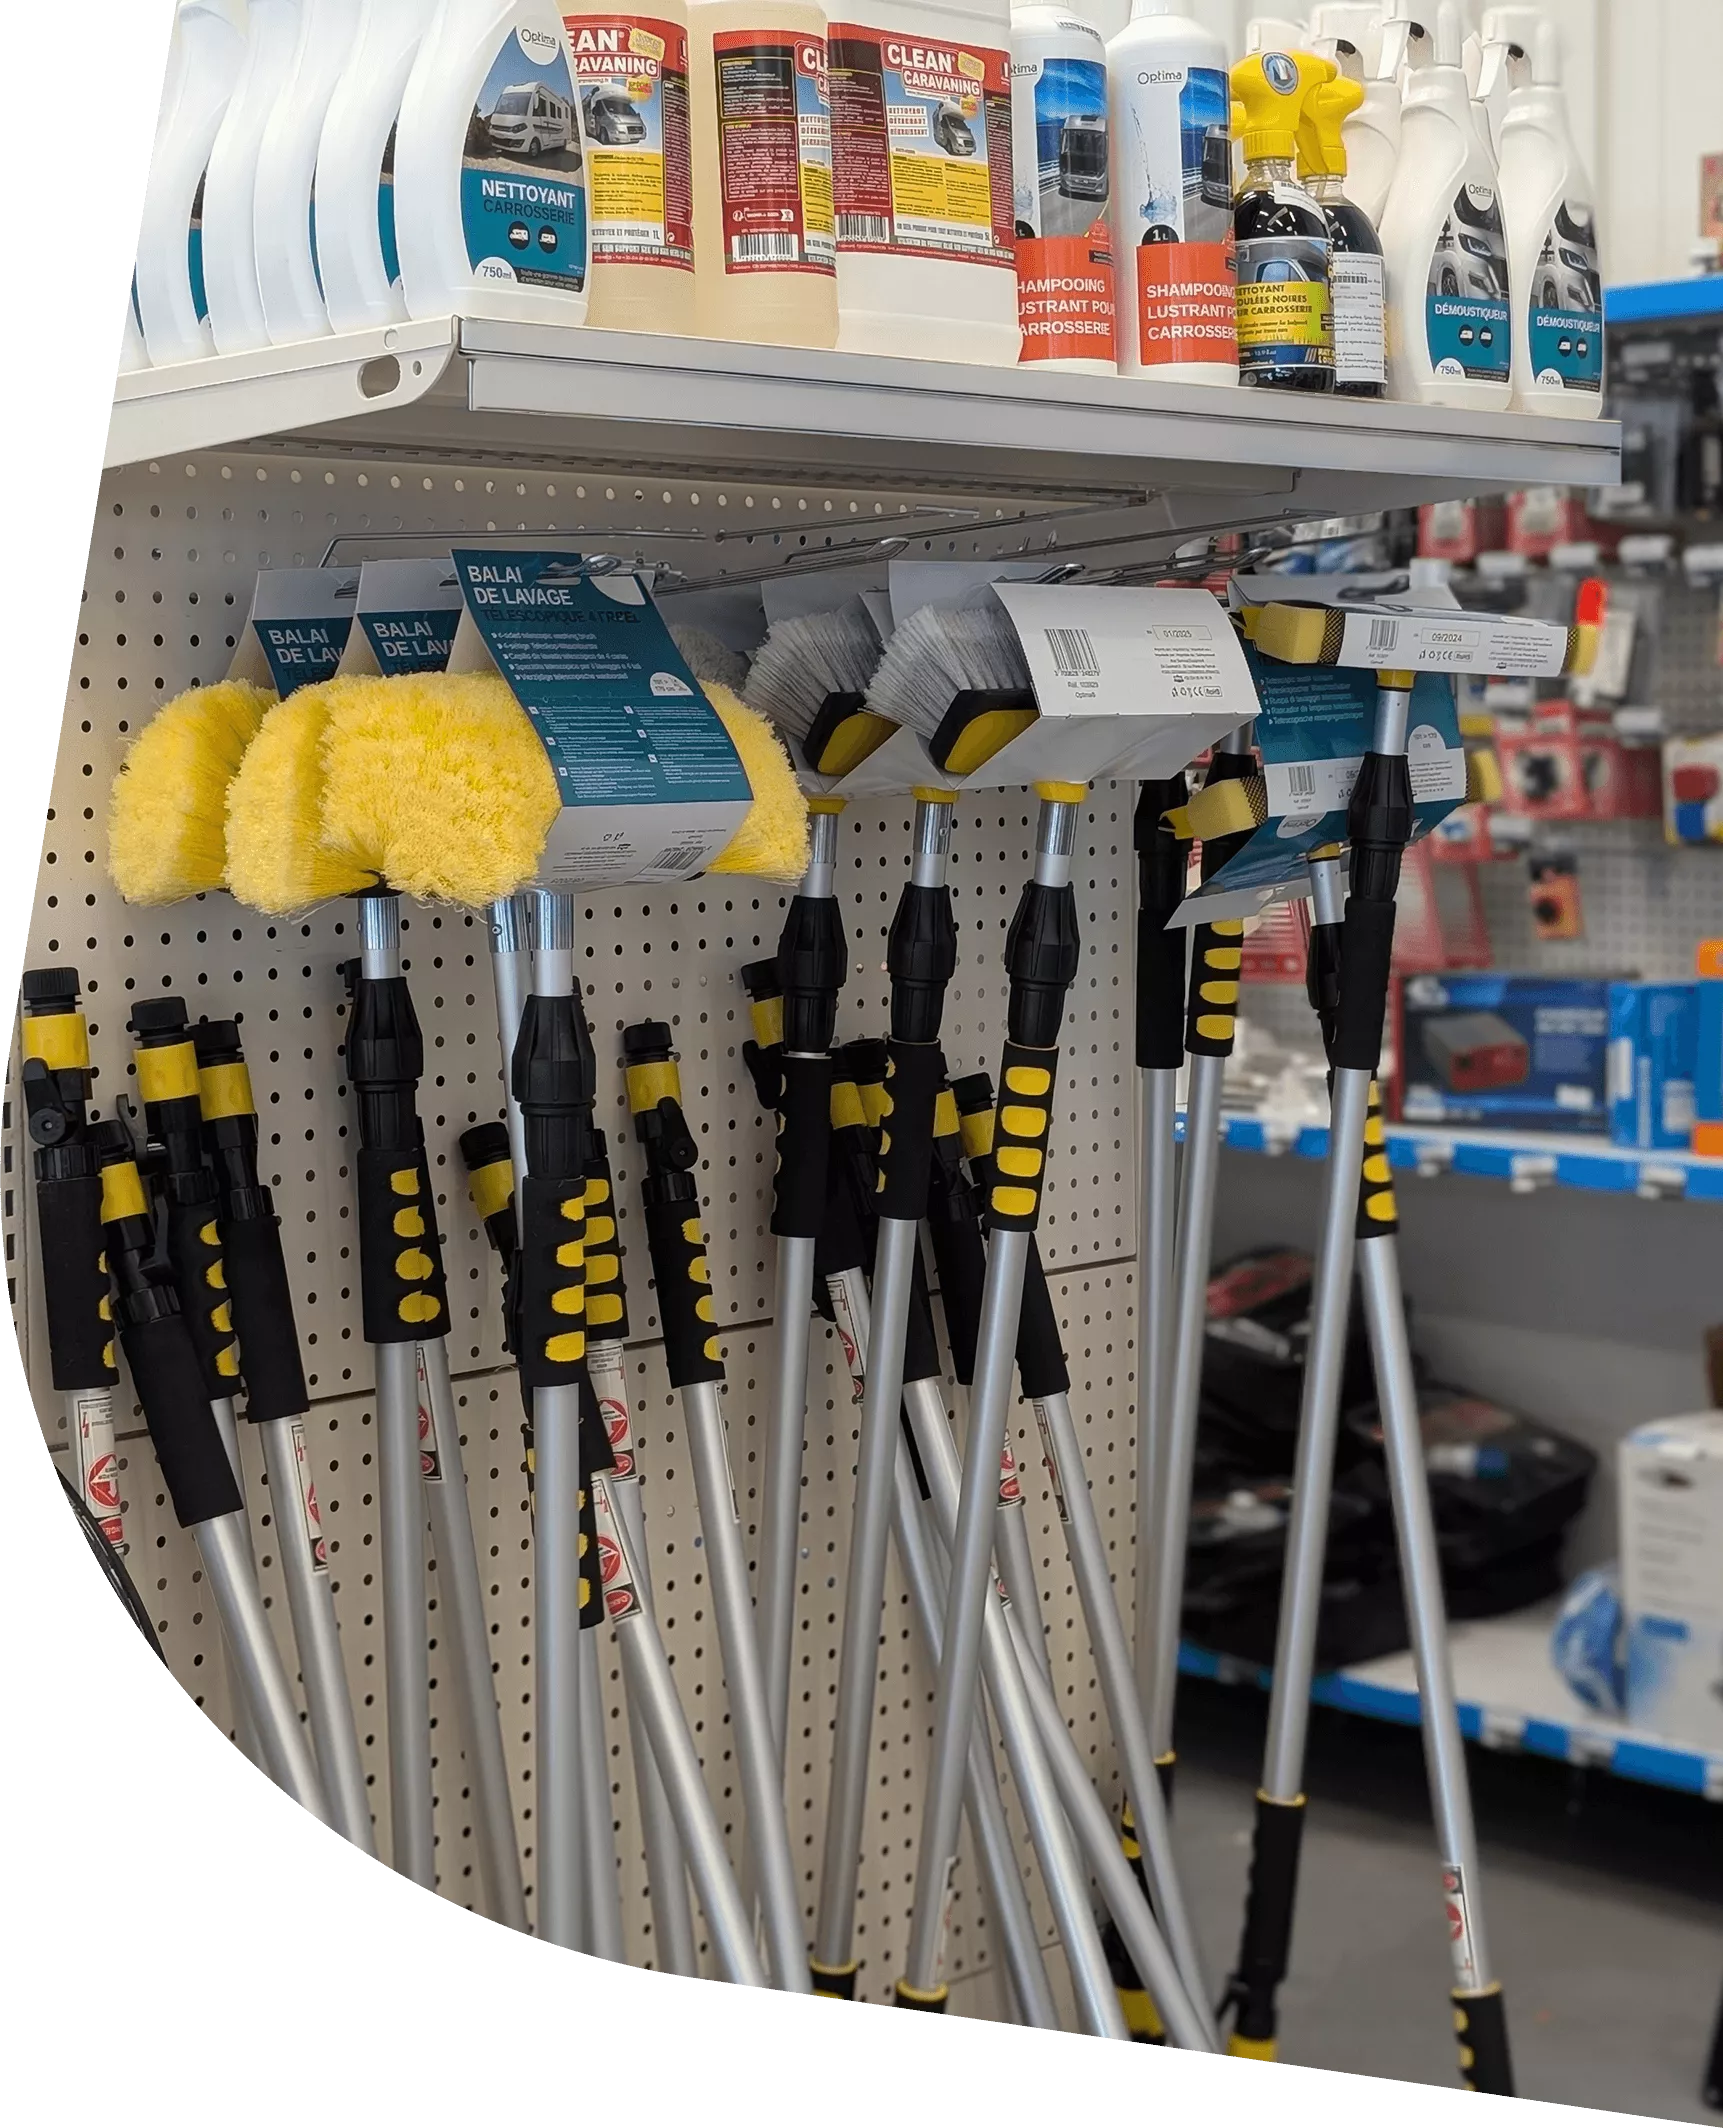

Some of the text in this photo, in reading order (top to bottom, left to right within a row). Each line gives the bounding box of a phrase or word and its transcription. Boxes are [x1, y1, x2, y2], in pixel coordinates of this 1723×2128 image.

[520, 28, 556, 47] Optima
[575, 57, 657, 76] AVANING
[887, 44, 953, 74] CLEAN
[903, 72, 980, 96] CARAVANING
[1137, 71, 1183, 85] Optima
[481, 178, 576, 209] NETTOYANT
[483, 199, 575, 226] CARROSSERIE
[482, 265, 512, 279] 750ml
[1272, 293, 1308, 304] NOIRES
[1147, 304, 1226, 320] LUSTRANT
[1251, 305, 1313, 316] CARROSSERIE
[1434, 302, 1508, 322] DÉMOUSTIQUEUR
[467, 565, 523, 584] BALAI
[474, 587, 574, 606] DE LAVAGE
[268, 628, 330, 645] BALAI
[372, 621, 433, 638] BALAI
[1431, 632, 1463, 643] 09/2024
[276, 648, 306, 664] DE
[382, 640, 455, 658] DE LAV
